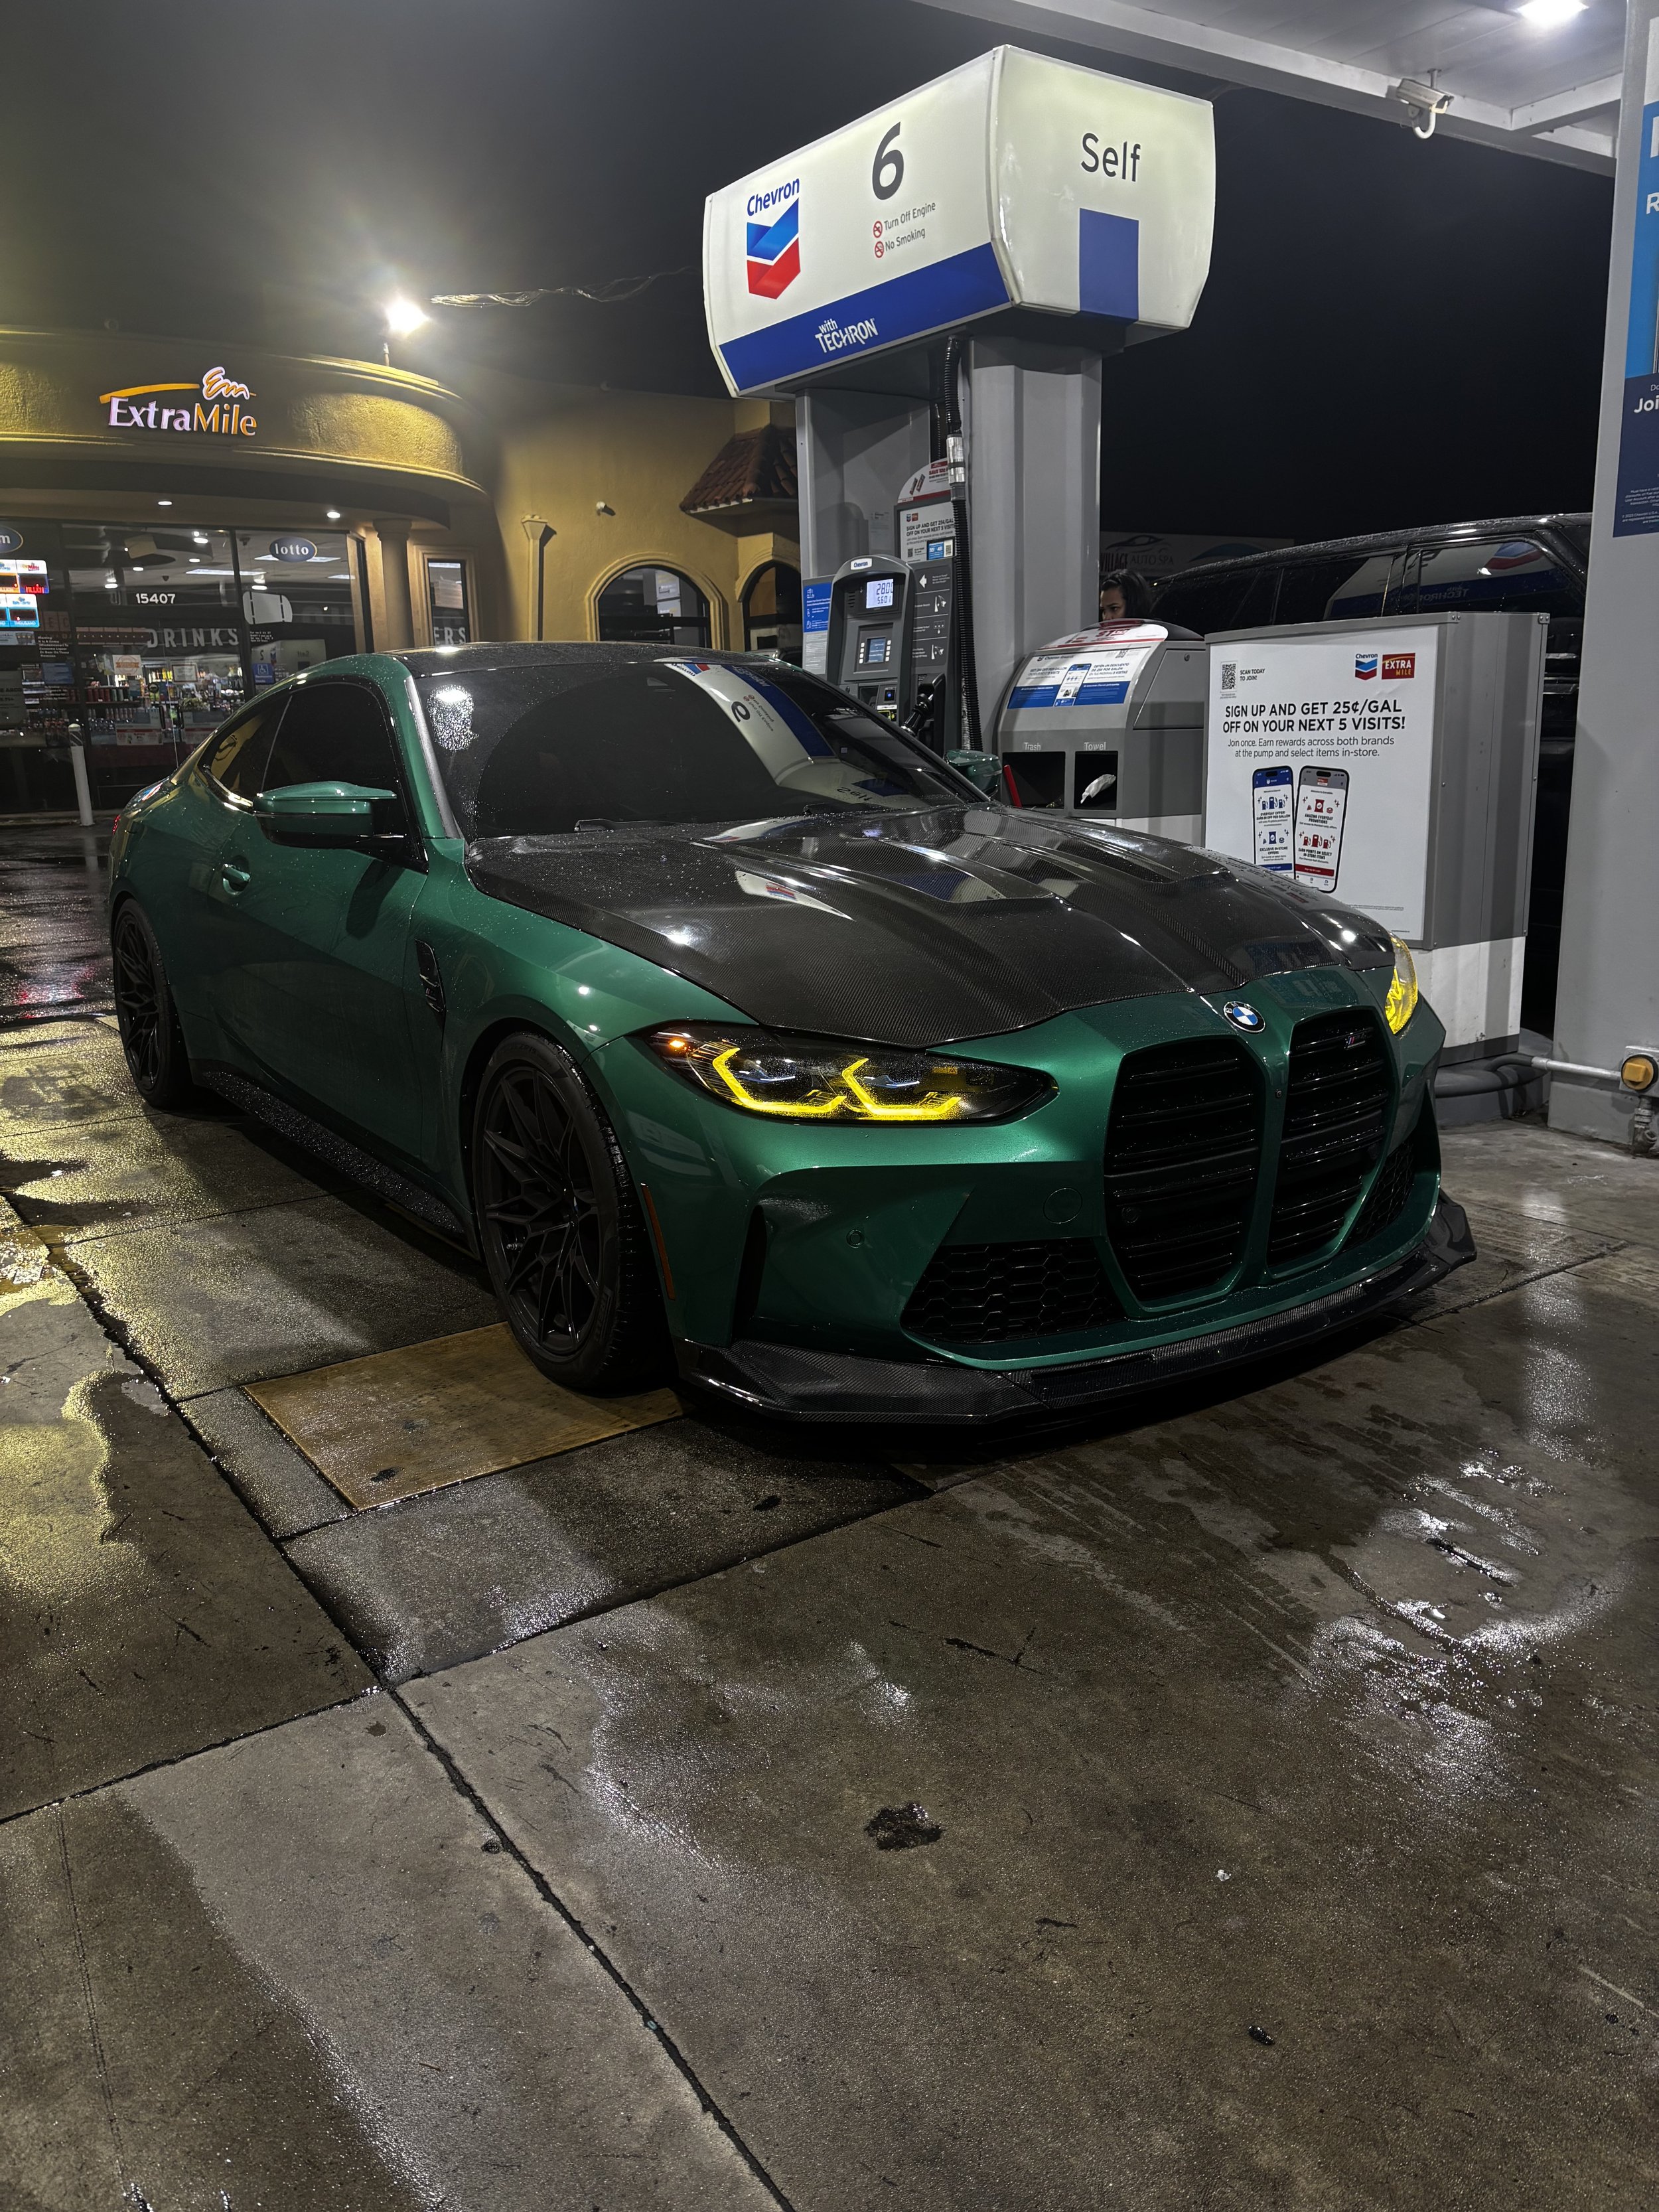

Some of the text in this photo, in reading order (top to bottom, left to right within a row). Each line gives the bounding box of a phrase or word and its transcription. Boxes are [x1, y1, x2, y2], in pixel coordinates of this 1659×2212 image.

[872, 122, 904, 200] 6
[1081, 132, 1141, 182] Self
[747, 178, 800, 216] Chevron
[884, 202, 936, 231] Turn Off Engine
[885, 228, 926, 252] No Smoking
[818, 318, 838, 334] with
[108, 396, 257, 437] ExtraMile
[275, 542, 310, 556] lotto
[1130, 553, 1157, 565] AUTO
[1158, 554, 1174, 565] SPA
[135, 593, 176, 604] 15407
[147, 627, 240, 648] DRINKS
[1385, 659, 1412, 670] EXTRA
[1225, 698, 1402, 717] SIGN UP AND GET 25¢/GAL
[1222, 716, 1406, 733] OFF ON YOUR NEXT 5 VISITS!
[1024, 741, 1106, 751] Trash Towel
[1228, 739, 1240, 747] Join
[1258, 737, 1274, 747] Earn
[1275, 737, 1306, 747] rewards
[1307, 737, 1334, 746] across
[1336, 736, 1358, 745] both
[1361, 735, 1395, 745] brands
[1242, 749, 1252, 757] the
[1254, 750, 1273, 759] pump
[1275, 748, 1289, 757] and
[1290, 748, 1314, 757] select
[1316, 747, 1340, 757] items
[1342, 747, 1380, 757] in-store.
